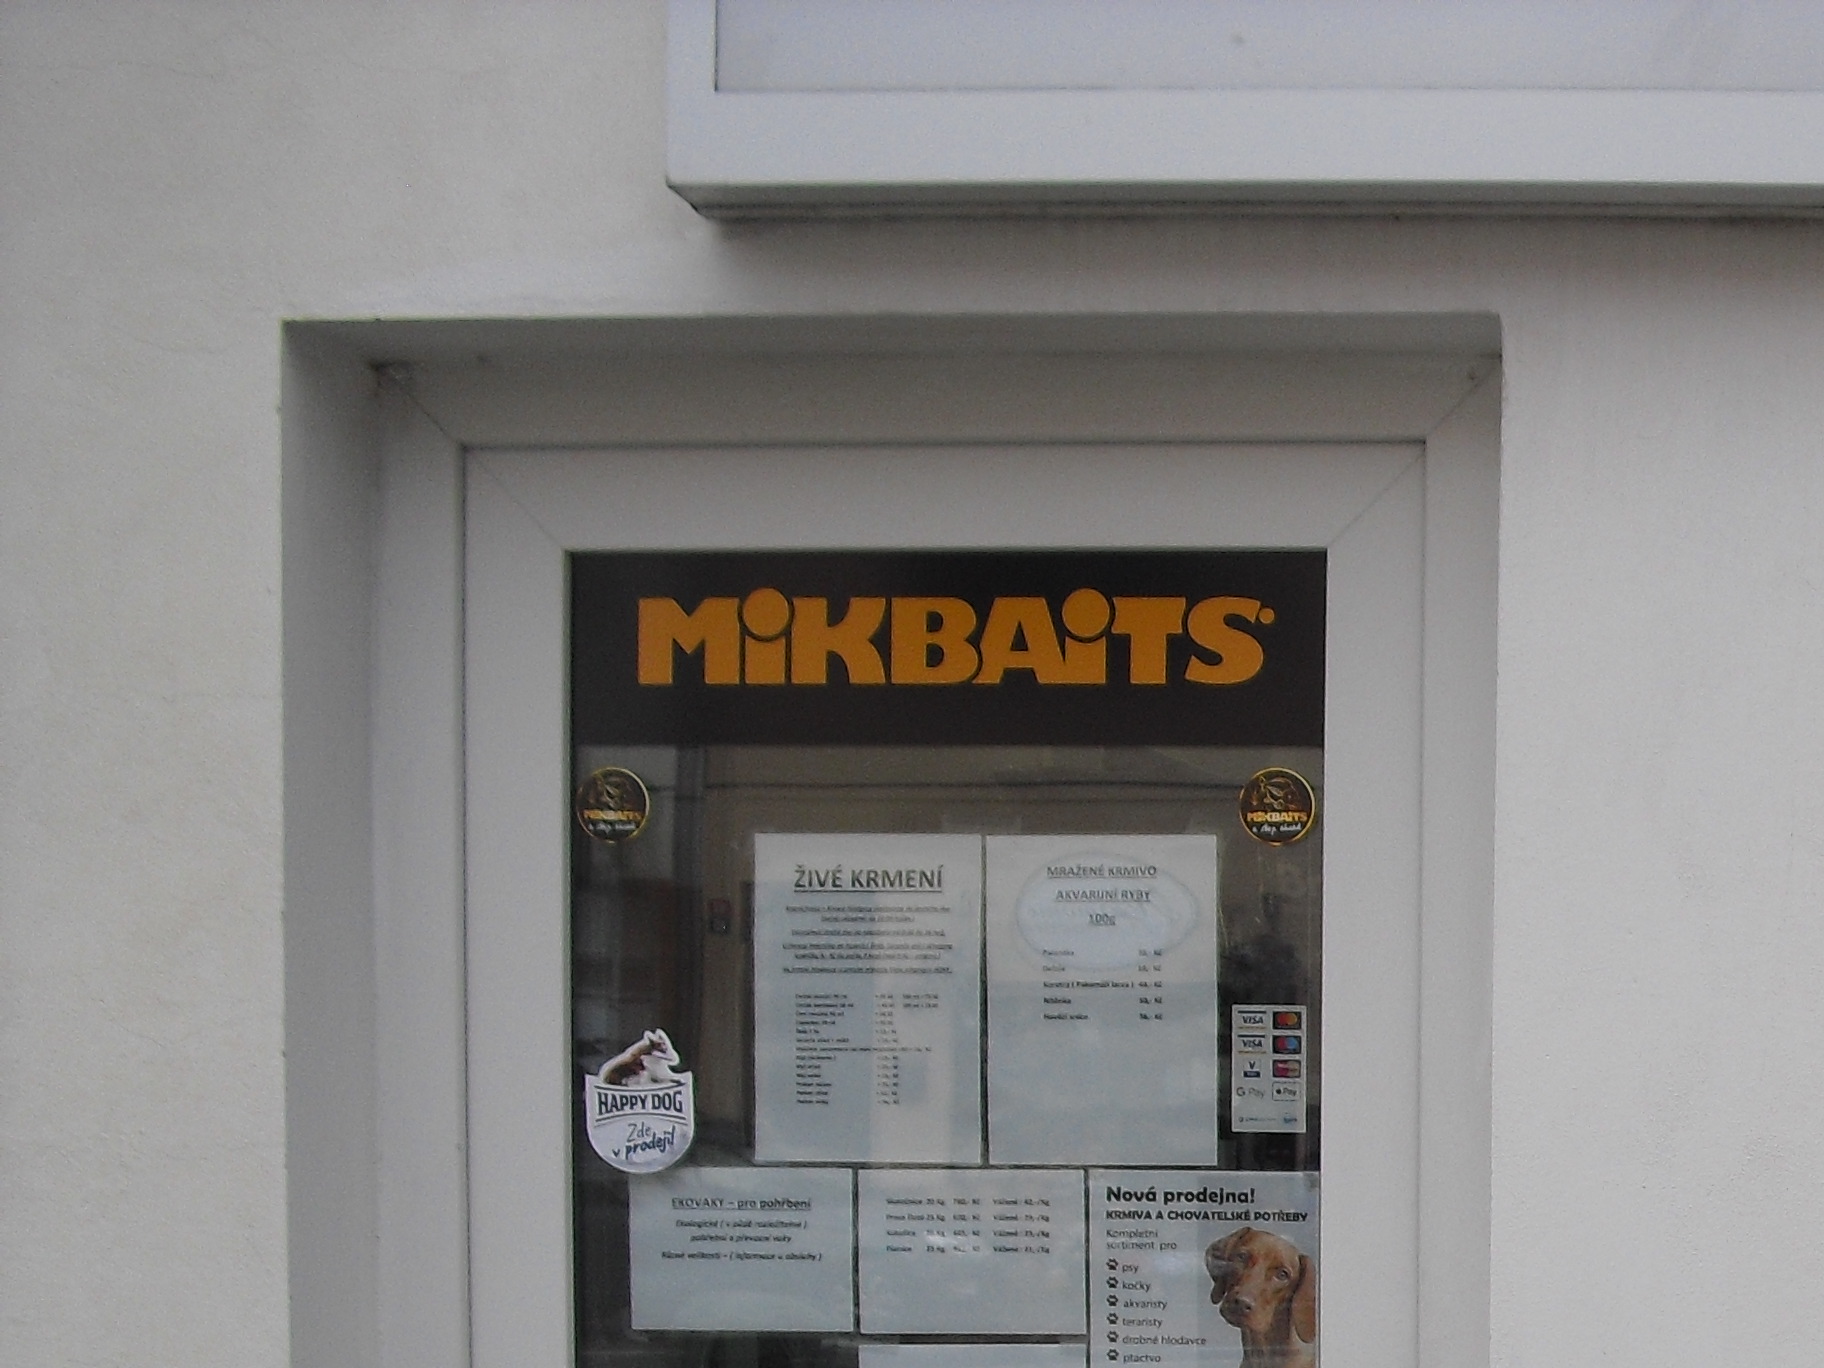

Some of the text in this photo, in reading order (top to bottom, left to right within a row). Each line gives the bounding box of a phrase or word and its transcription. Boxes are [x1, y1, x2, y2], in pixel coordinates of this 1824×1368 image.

[1047, 864, 1157, 876] MRAŽENÉ KRMIVO
[794, 865, 944, 888] ŽIVÉ KRMENÍ
[1119, 889, 1151, 900] RYBY
[1242, 1015, 1264, 1024] VISA
[1241, 1039, 1262, 1048] VISA
[597, 1090, 683, 1115] HAPPY DOG
[626, 1121, 651, 1142] Zde
[612, 1148, 620, 1158] v
[1106, 1186, 1256, 1206] Nová prodejna!
[737, 1200, 757, 1210] pro
[1106, 1208, 1309, 1222] KRMIVA A CHOVATELSKÉ POTŘEBY
[1106, 1228, 1158, 1240] Kompletní
[1106, 1240, 1178, 1252] sortiment pro
[1122, 1264, 1139, 1274] psy
[1122, 1281, 1151, 1293] kočky
[1123, 1300, 1168, 1311] akvaristy
[1122, 1317, 1163, 1329] teraristy
[1122, 1335, 1207, 1346] drobné hlodavce
[1123, 1354, 1161, 1365] ptactvo
